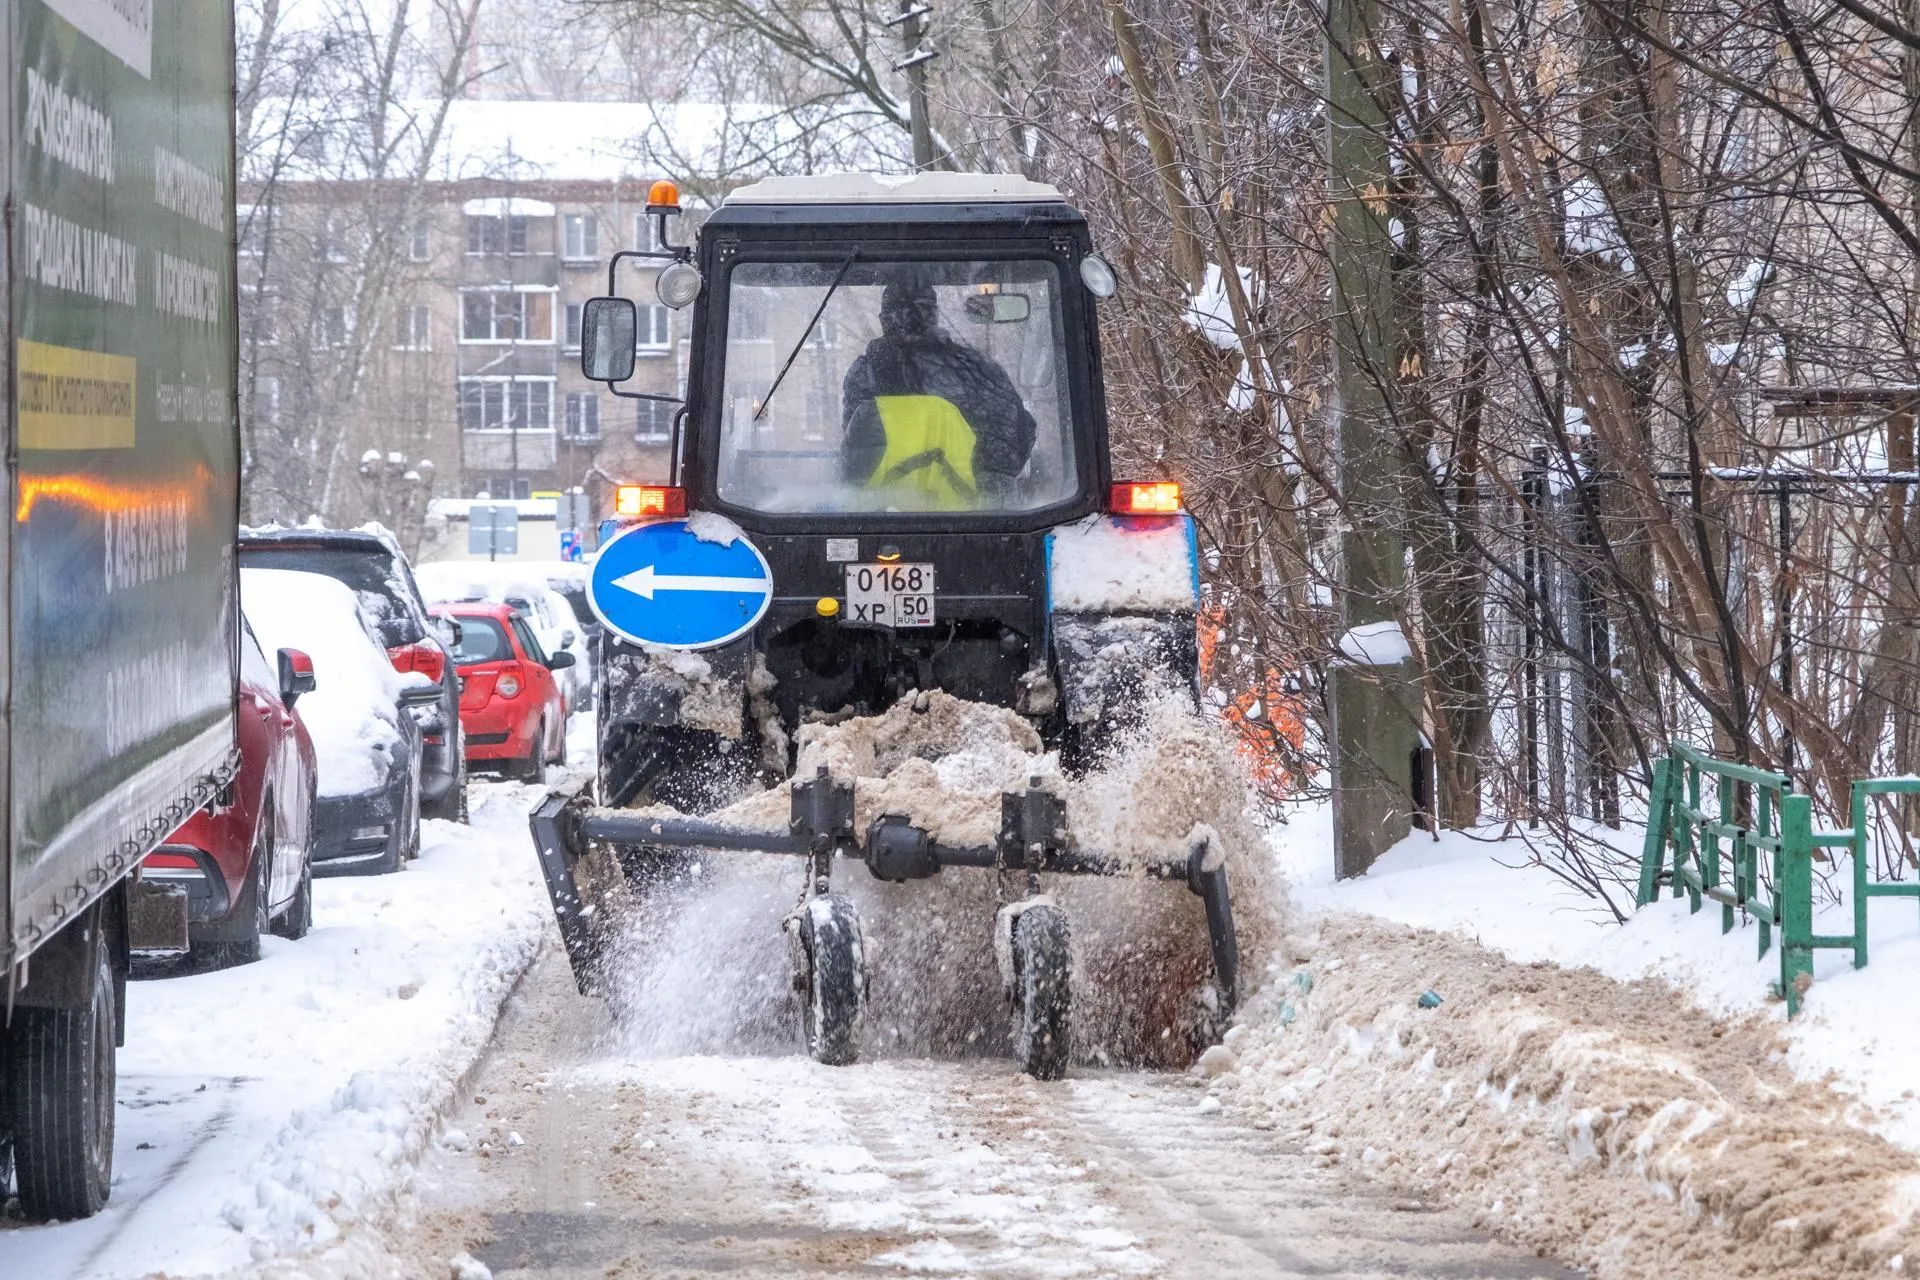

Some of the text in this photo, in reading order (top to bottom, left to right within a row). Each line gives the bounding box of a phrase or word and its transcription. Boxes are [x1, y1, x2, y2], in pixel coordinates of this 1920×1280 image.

[25, 202, 136, 308] ПРОДАЖА И МОНТАЖ
[105, 510, 113, 595] 8
[116, 503, 137, 589] 495
[857, 567, 923, 593] 0168
[903, 597, 928, 616] 50
[897, 616, 918, 625] RUS
